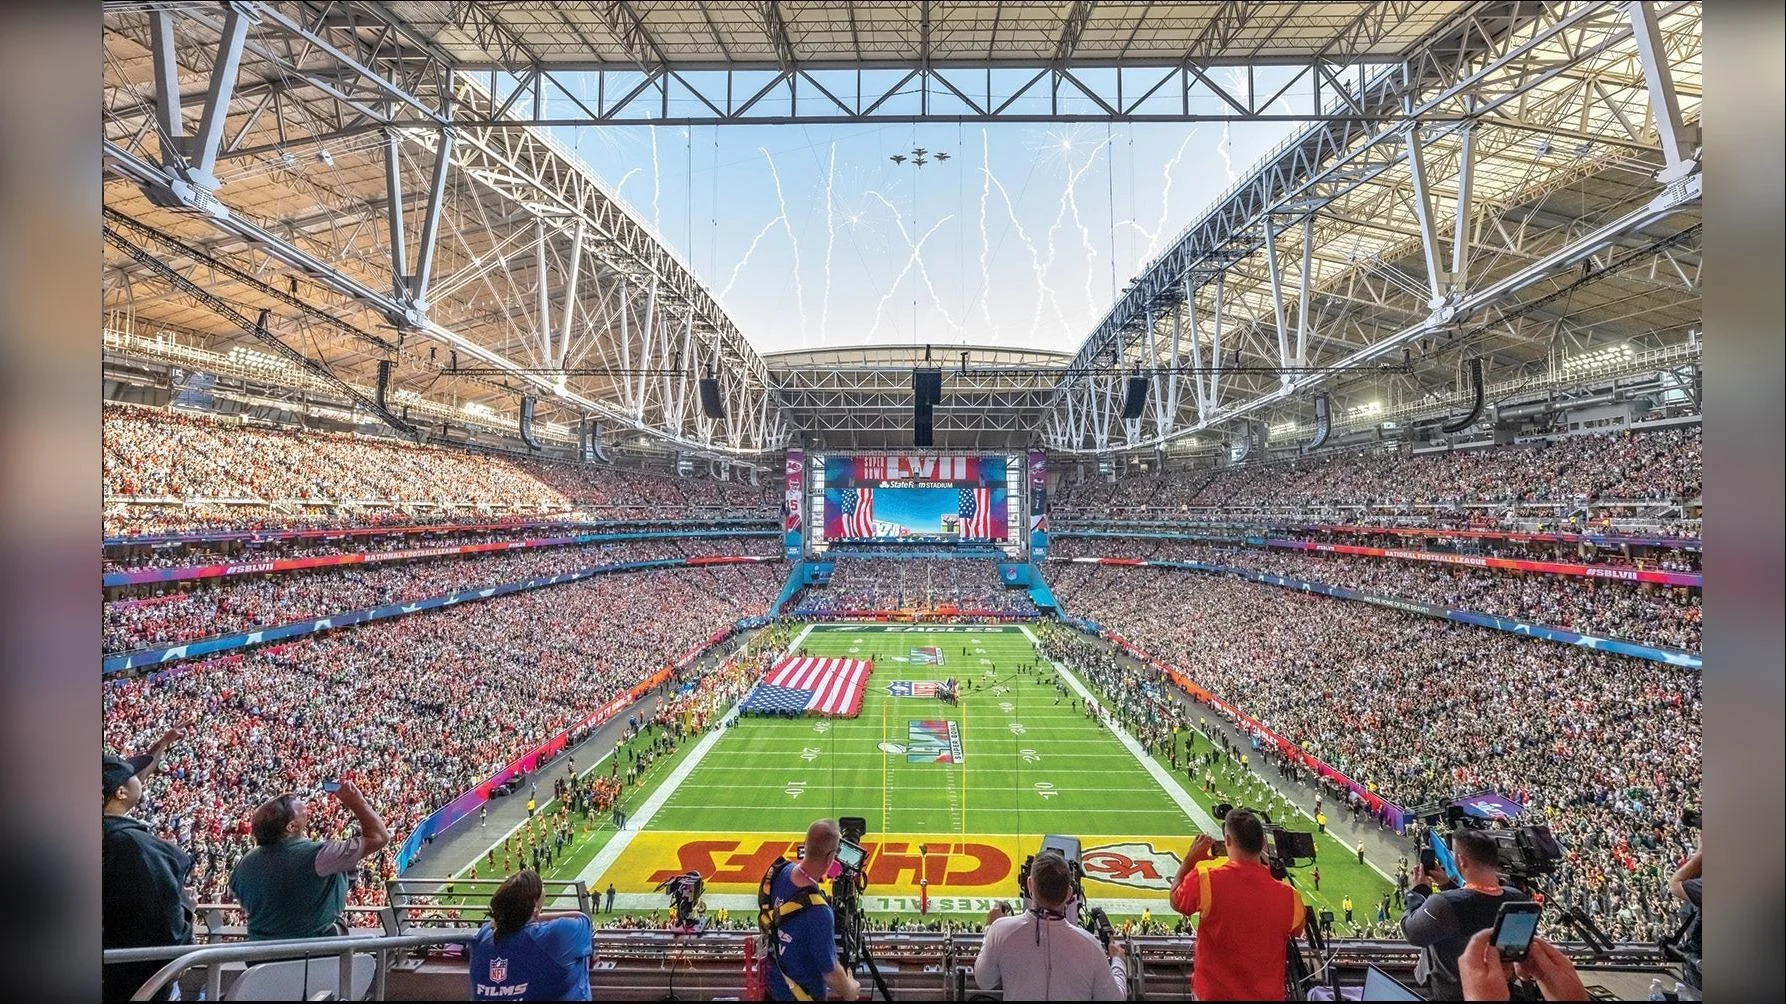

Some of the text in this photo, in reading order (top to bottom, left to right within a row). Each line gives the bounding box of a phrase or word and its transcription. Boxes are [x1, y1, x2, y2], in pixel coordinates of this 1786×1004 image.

[864, 468, 884, 480] BOWL
[887, 457, 966, 480] LVII
[364, 552, 403, 561] NATIONAL
[404, 549, 436, 558] FOOTBALL
[1384, 550, 1487, 566] NATIONAL FOOTBALL LEAGUE
[226, 563, 274, 574] #SBLVII
[1586, 568, 1637, 580] #SBLVII
[952, 741, 961, 760] SUPER
[785, 781, 807, 794] 10
[1035, 782, 1058, 796] 10
[877, 898, 928, 911] ALL
[942, 898, 1022, 911] TKES
[492, 968, 505, 979] NFL
[477, 982, 529, 996] FILMS
